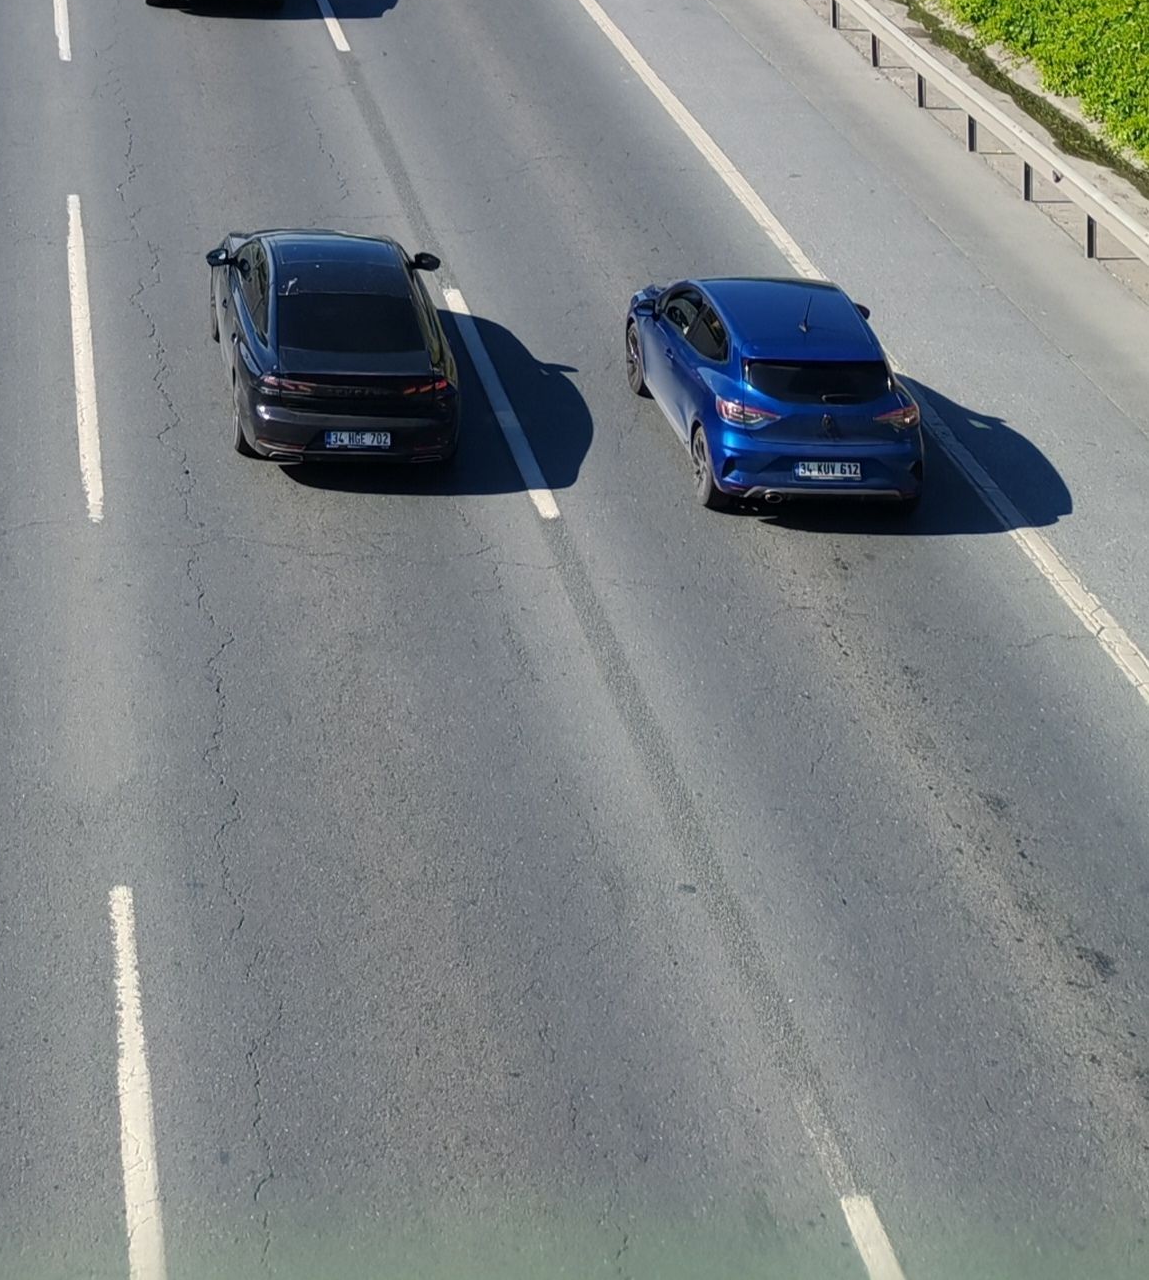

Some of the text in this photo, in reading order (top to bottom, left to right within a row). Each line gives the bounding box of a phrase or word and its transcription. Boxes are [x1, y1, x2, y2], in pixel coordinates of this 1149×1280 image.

[332, 432, 345, 444] 34
[371, 432, 389, 445] 702
[800, 463, 813, 475] 34
[840, 463, 859, 476] 612
